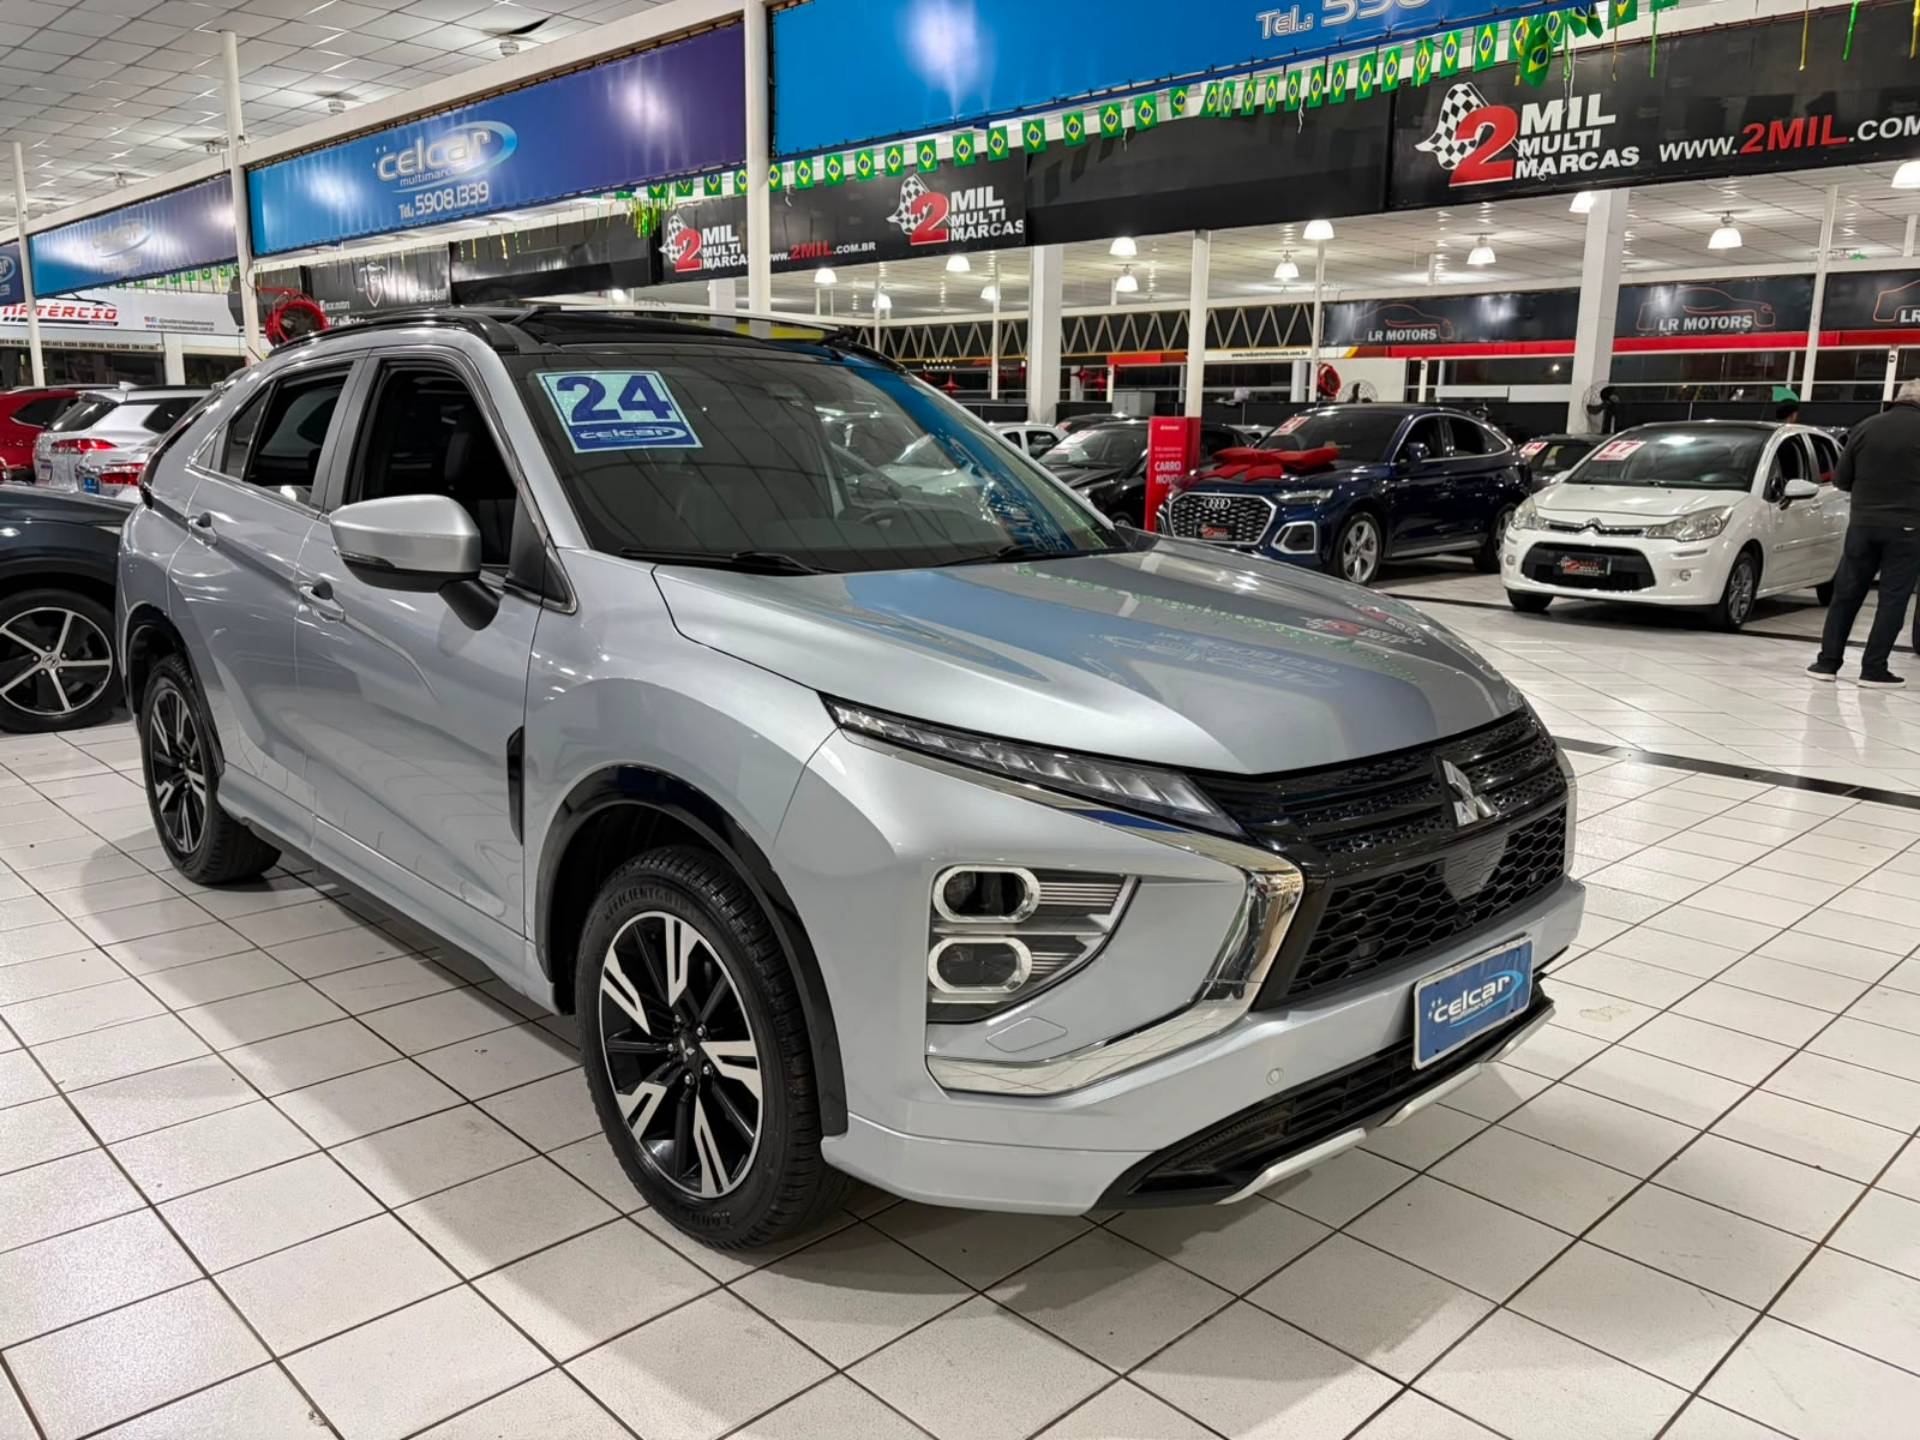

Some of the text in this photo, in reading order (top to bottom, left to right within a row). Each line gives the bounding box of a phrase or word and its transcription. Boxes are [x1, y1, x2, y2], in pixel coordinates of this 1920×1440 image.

[1256, 4, 1313, 39] Tel.:
[377, 129, 491, 181] celcar
[1448, 93, 1616, 187] 2 MIL
[1518, 128, 1601, 158] MULTI
[1515, 146, 1640, 179] MARCAS
[415, 181, 490, 216] 5908.1339
[910, 186, 1004, 246] 2 MIL
[951, 207, 1006, 229] MULTI
[951, 219, 1024, 242] MARCAS
[675, 225, 739, 272] 2 MIL
[702, 243, 741, 258] MULTI
[702, 256, 749, 271] MARCA
[1368, 329, 1437, 342] LR MOTORS
[1658, 315, 1753, 332] LR MOTORS
[556, 375, 673, 423] 24
[579, 429, 670, 440] celcar
[1154, 461, 1182, 472] CARRO
[1433, 976, 1510, 1023] celcar
